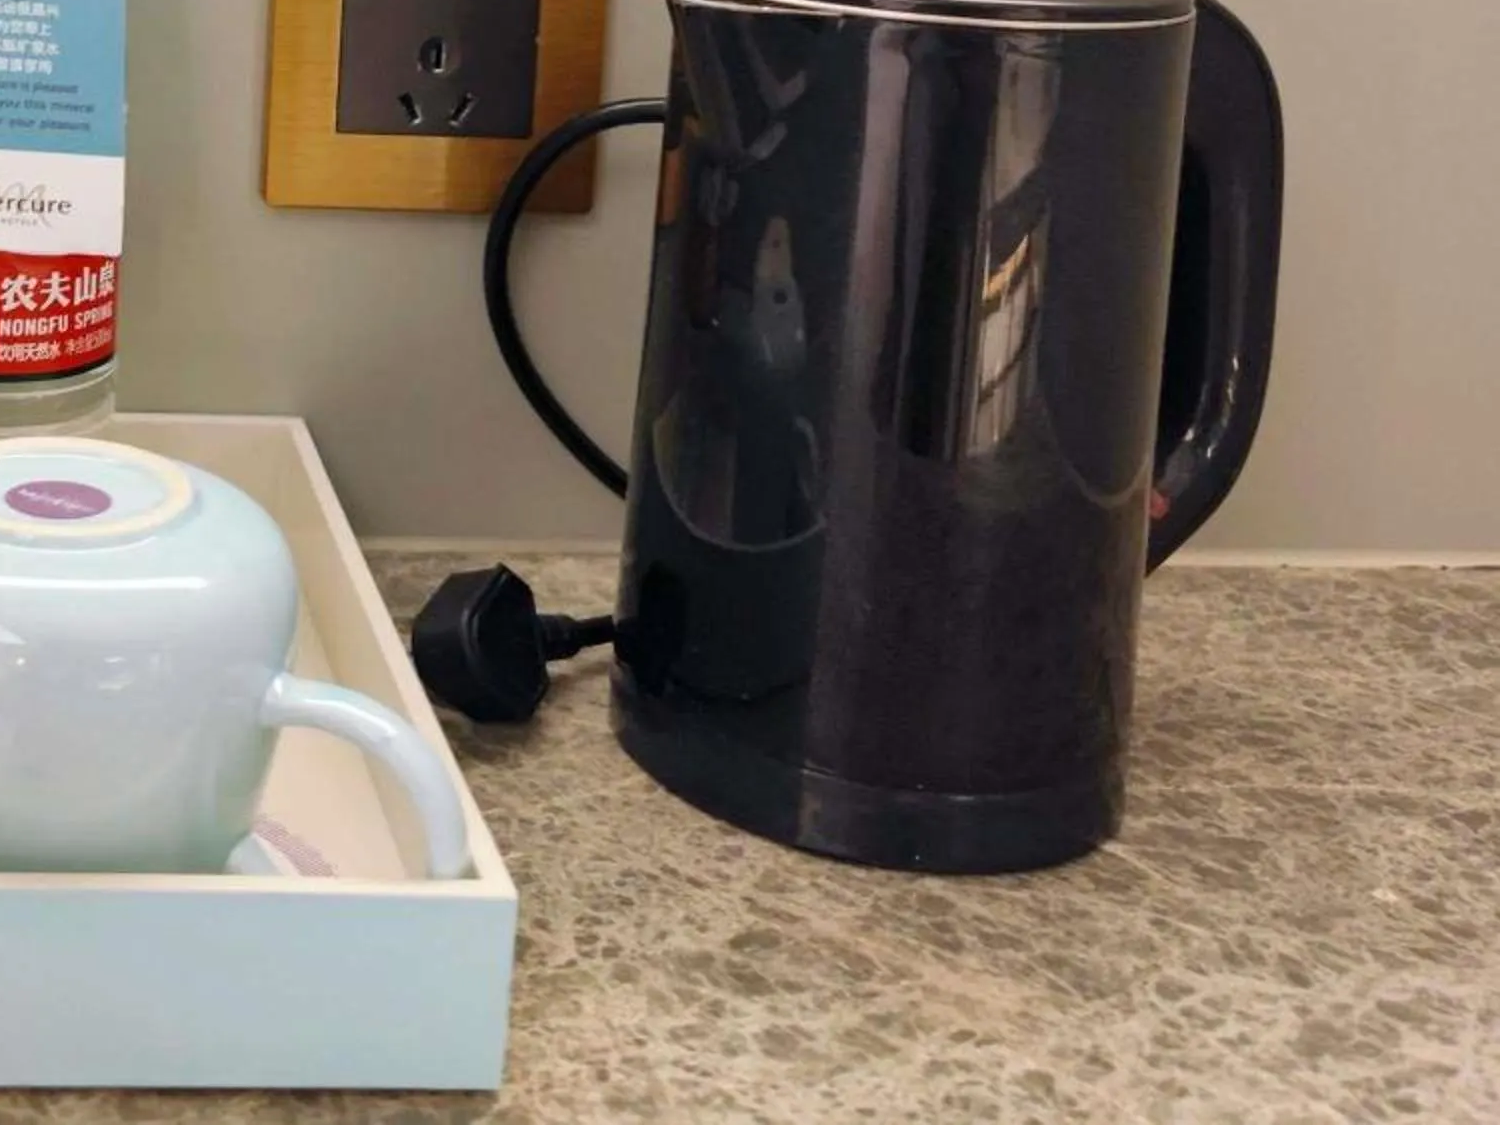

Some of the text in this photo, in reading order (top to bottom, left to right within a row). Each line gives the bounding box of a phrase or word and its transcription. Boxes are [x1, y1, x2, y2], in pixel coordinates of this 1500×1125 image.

[0, 260, 115, 312] 农夫山泉
[0, 314, 69, 336] NONGFU
